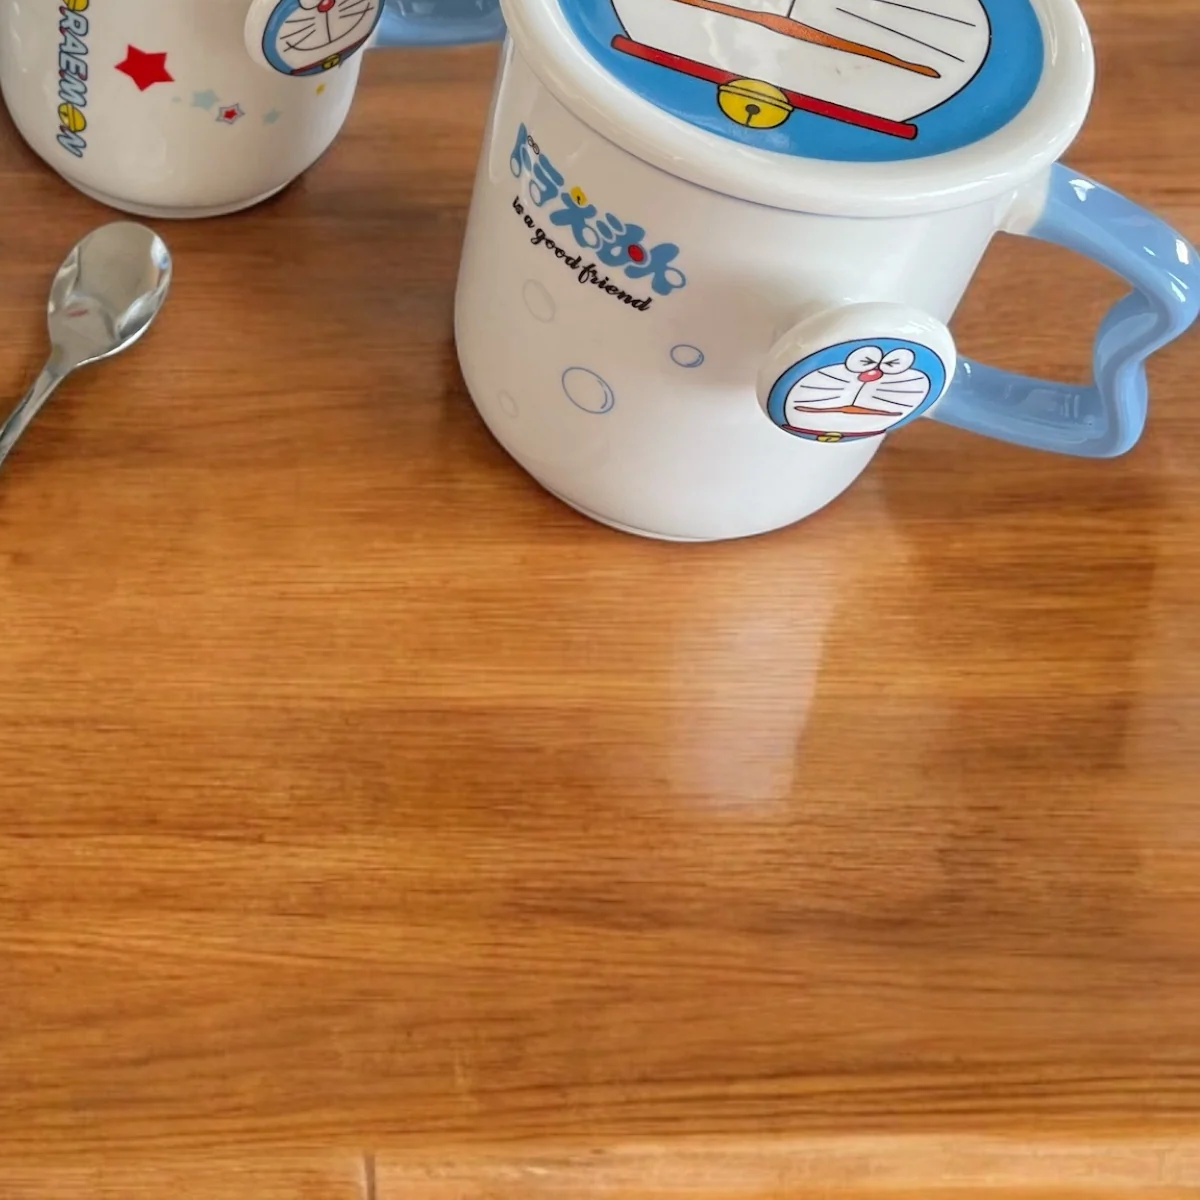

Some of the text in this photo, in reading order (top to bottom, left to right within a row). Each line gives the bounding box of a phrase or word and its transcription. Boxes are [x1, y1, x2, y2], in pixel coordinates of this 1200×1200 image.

[512, 196, 654, 312] is a good friend
